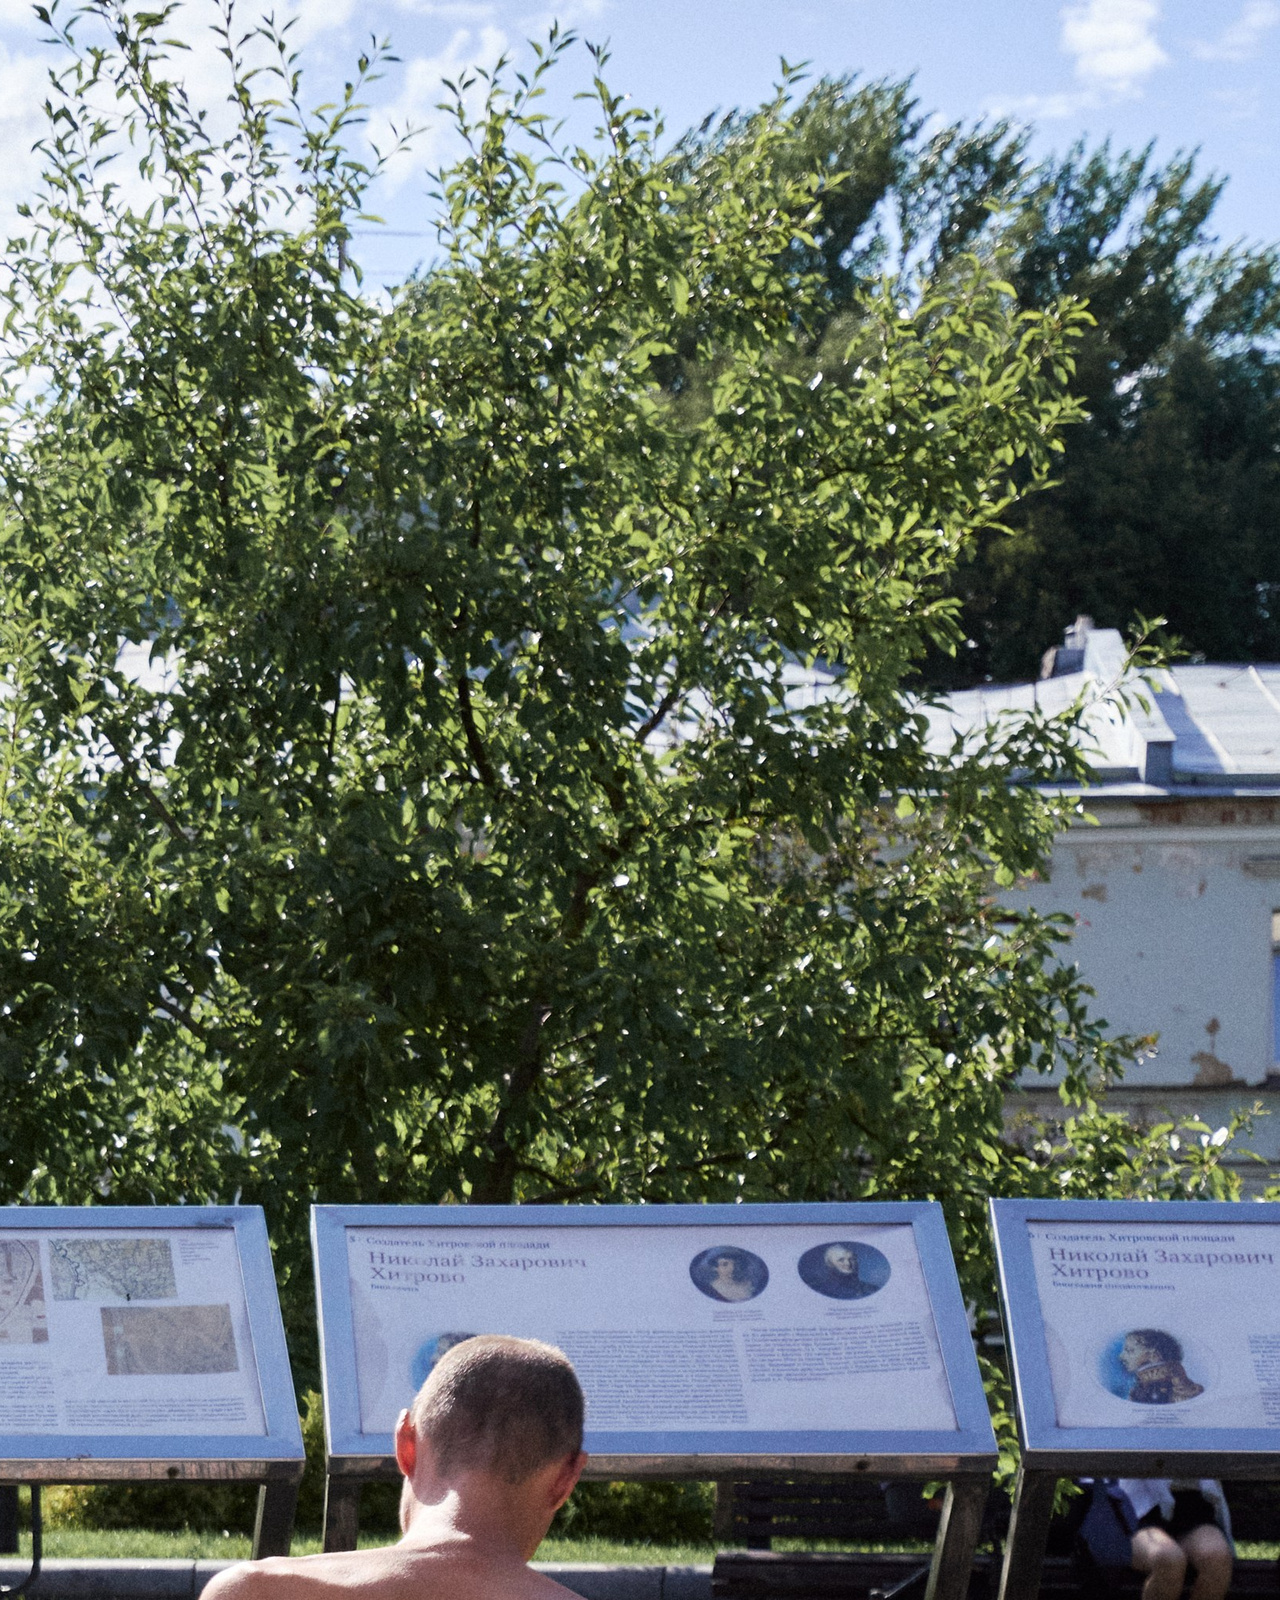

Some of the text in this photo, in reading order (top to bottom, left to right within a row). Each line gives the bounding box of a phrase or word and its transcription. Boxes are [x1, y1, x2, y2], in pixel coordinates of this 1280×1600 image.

[1045, 1232, 1106, 1243] Создатель
[1109, 1233, 1179, 1244] Хитровской
[1182, 1234, 1235, 1244] площади
[370, 1251, 588, 1272] Никлай Захарович
[1049, 1247, 1274, 1267] Николай Захарович
[1052, 1263, 1149, 1282] Хитрово
